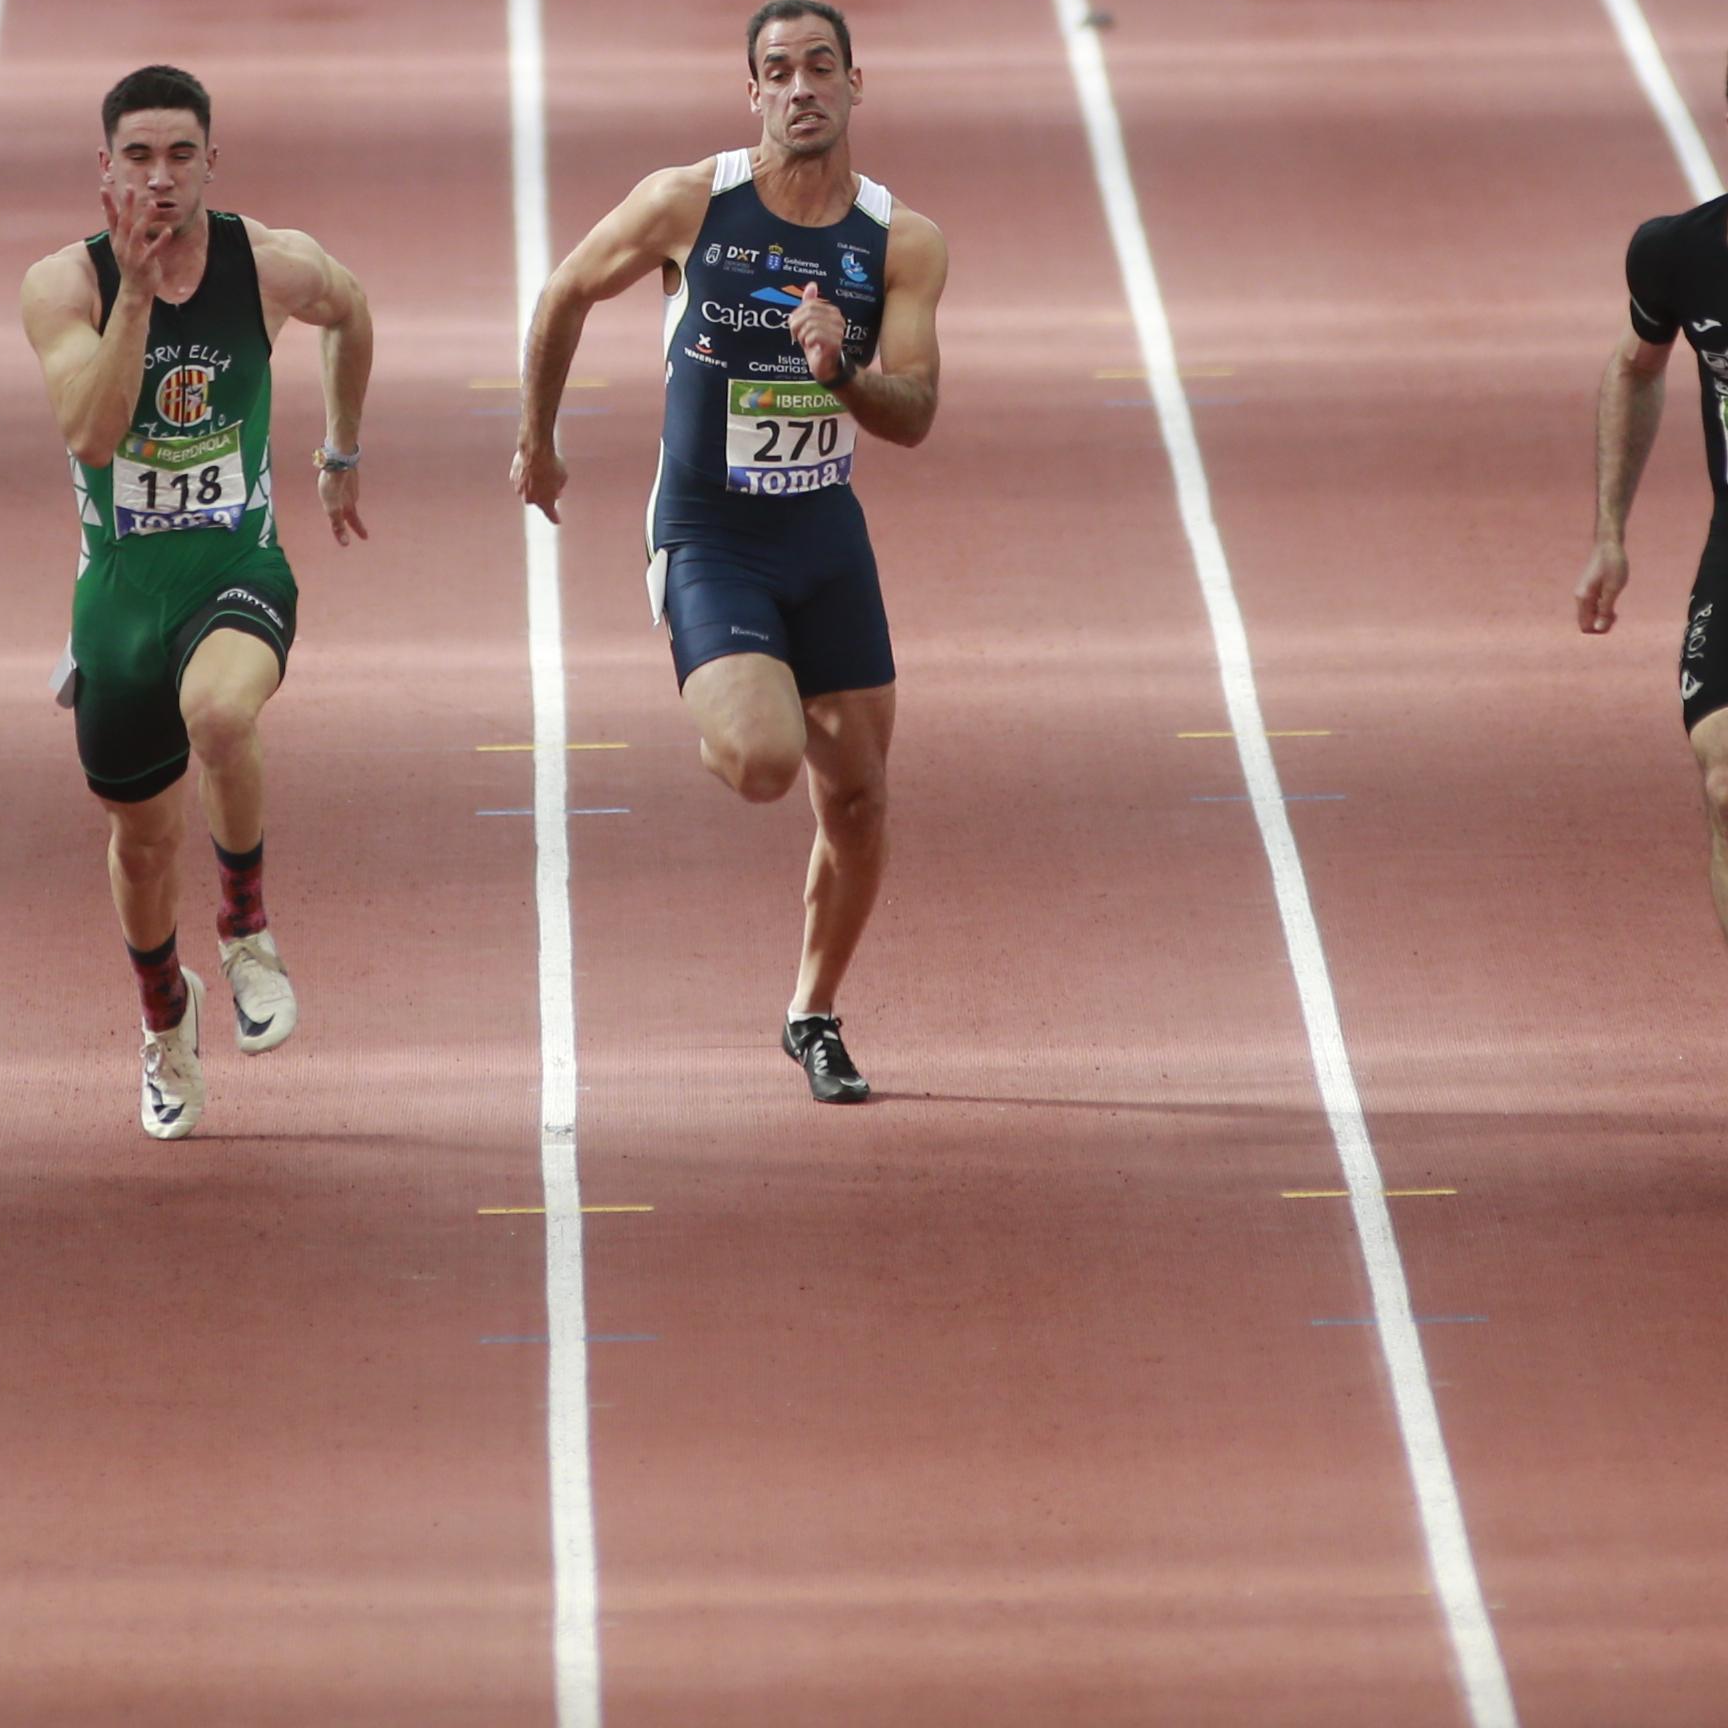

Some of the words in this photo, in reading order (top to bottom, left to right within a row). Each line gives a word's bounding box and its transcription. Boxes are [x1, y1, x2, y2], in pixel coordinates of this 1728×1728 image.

[726, 246, 760, 262] DXT
[783, 256, 820, 268] Gobierno
[793, 265, 828, 276] Canarias
[701, 300, 868, 340] CajaCaias
[684, 347, 728, 369] TENERIFE
[778, 354, 808, 365] Islas
[749, 361, 808, 374] Canarias
[775, 393, 841, 409] IBERDR
[754, 417, 838, 462] 270
[156, 433, 232, 463] IBERDROLA
[138, 465, 222, 512] 118
